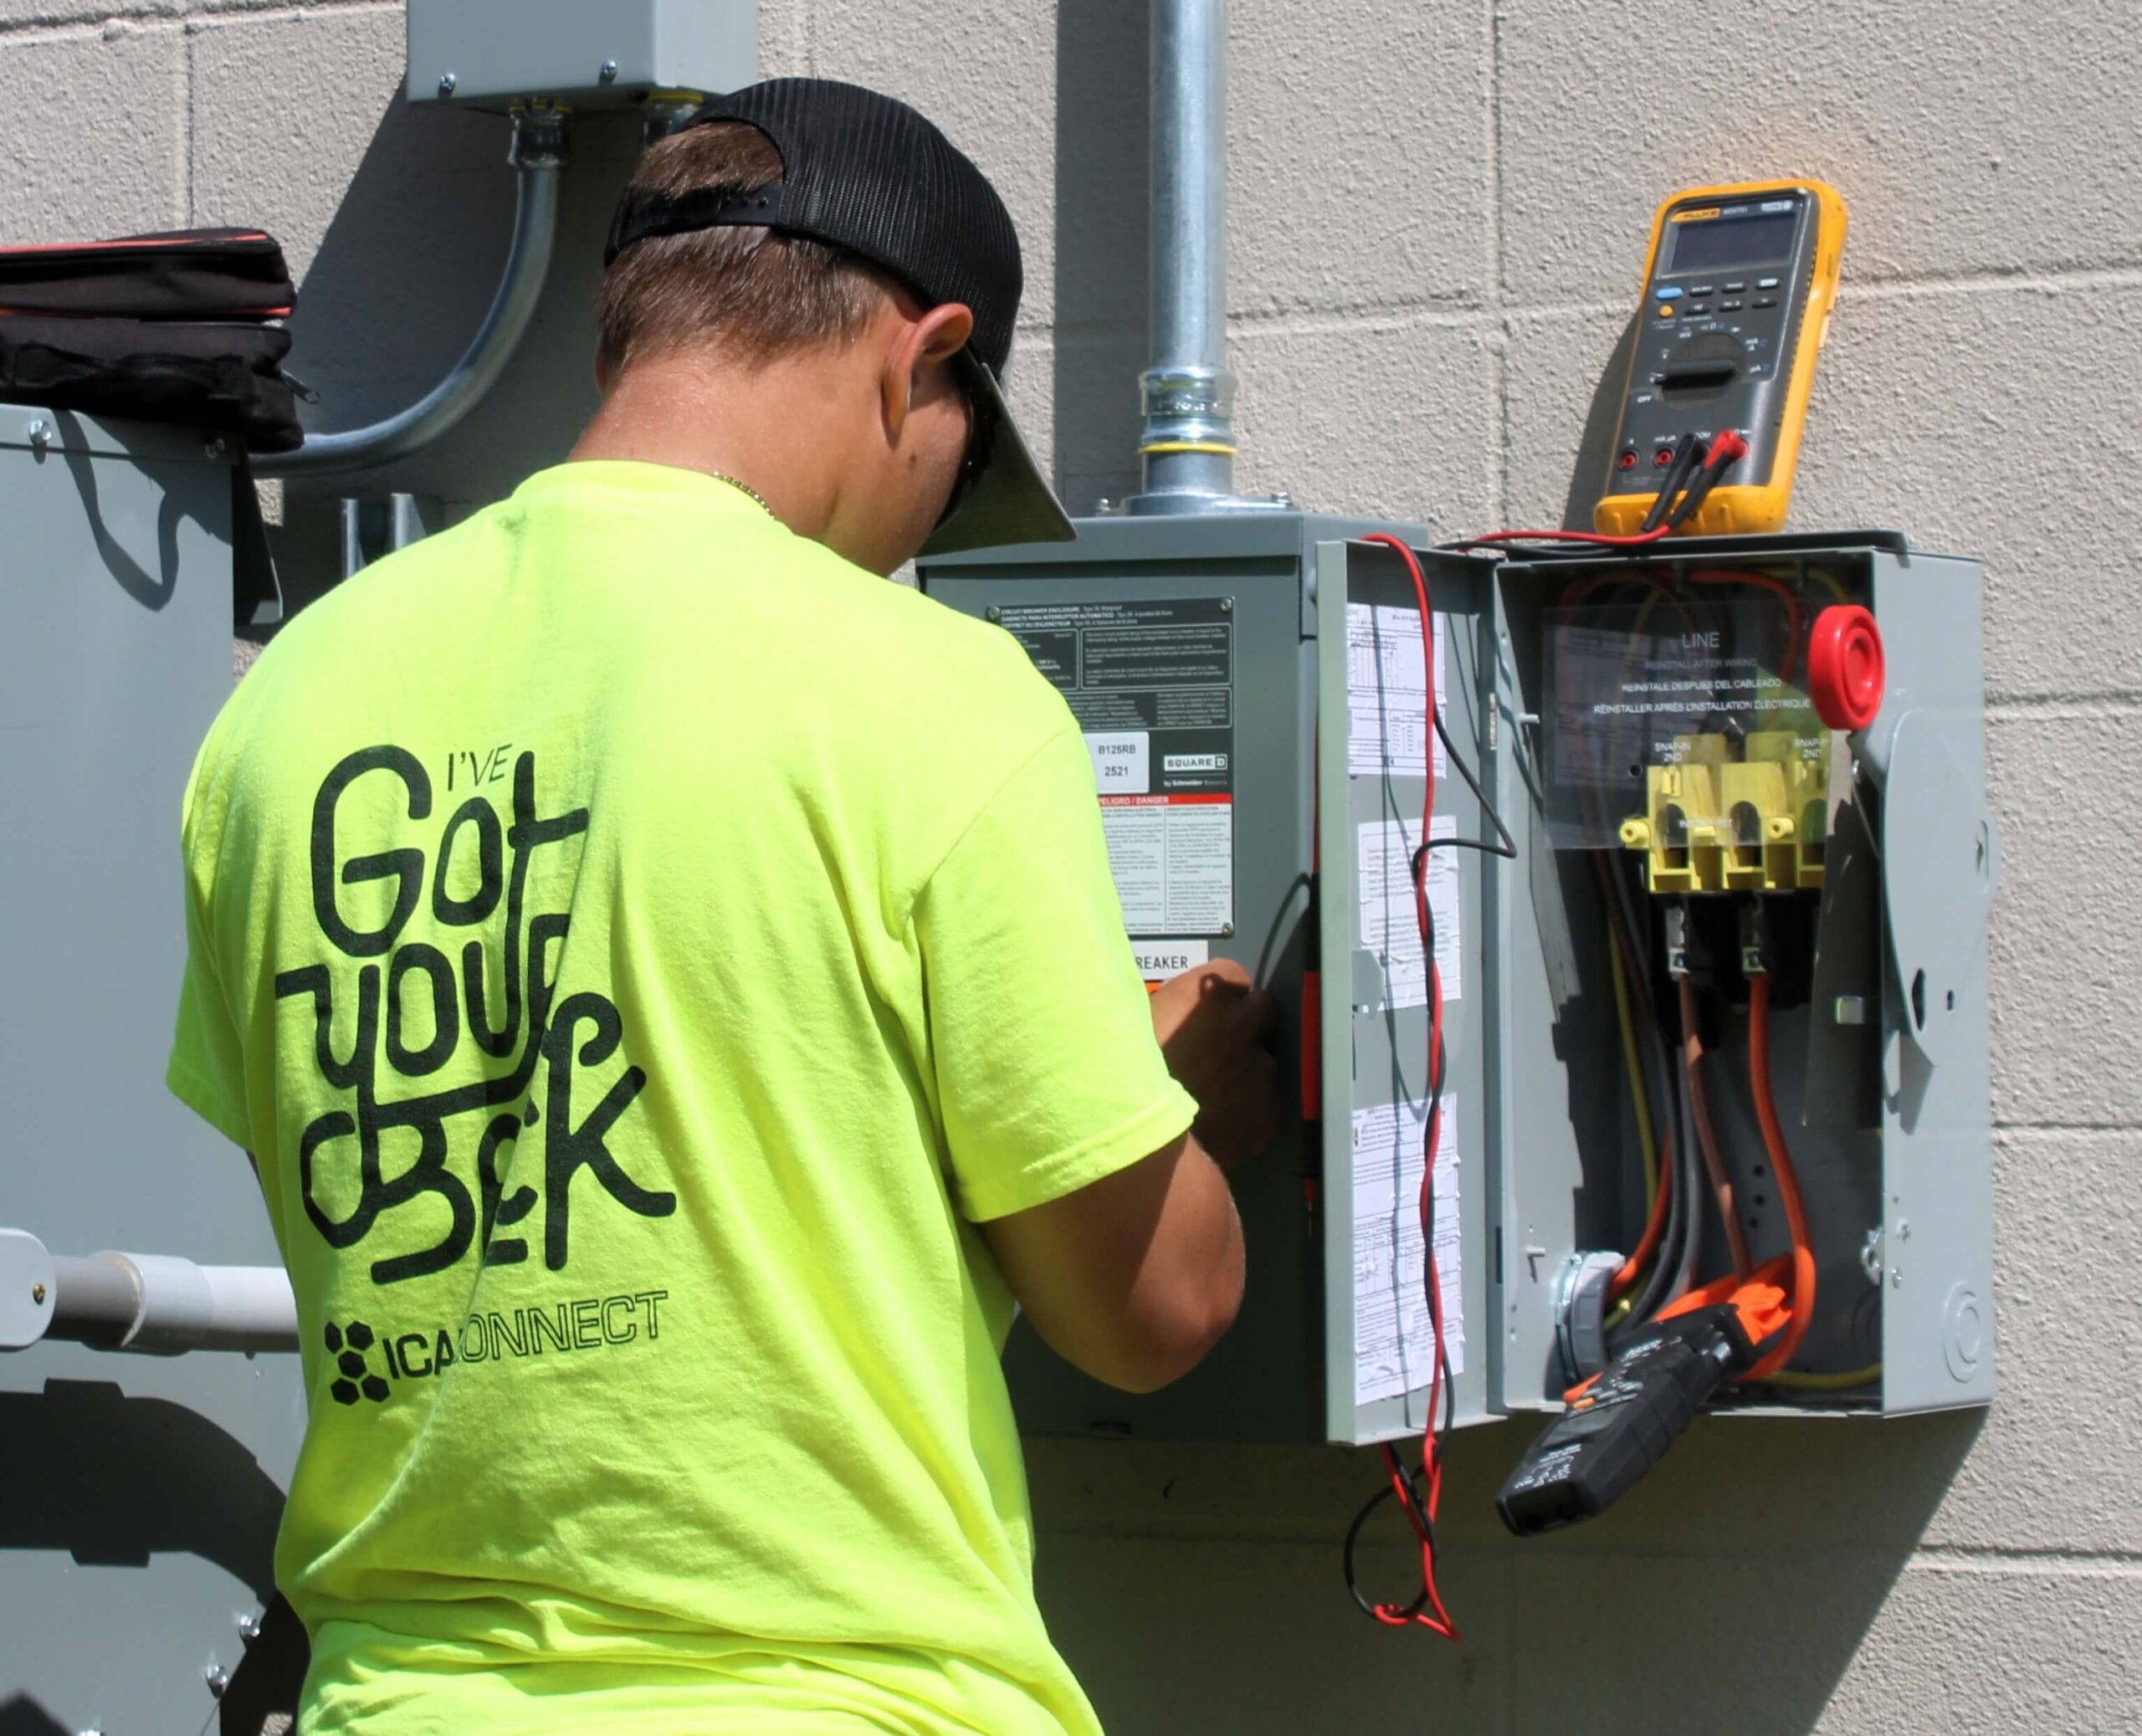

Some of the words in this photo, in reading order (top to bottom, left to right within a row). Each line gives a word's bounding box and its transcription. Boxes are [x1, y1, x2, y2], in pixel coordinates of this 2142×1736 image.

[1637, 395, 1652, 403] OFF
[1683, 632, 1720, 648] LINE
[1622, 682, 1670, 693] REINSTALE
[1715, 679, 1733, 689] DEL
[1734, 678, 1782, 689] CABLEADO
[1098, 744, 1137, 755] B125RB
[448, 744, 513, 791] I'VE
[1167, 758, 1214, 768] SQUARE
[1104, 766, 1129, 777] 2521
[1135, 795, 1170, 806] DANGER
[1135, 955, 1189, 970] REAKER
